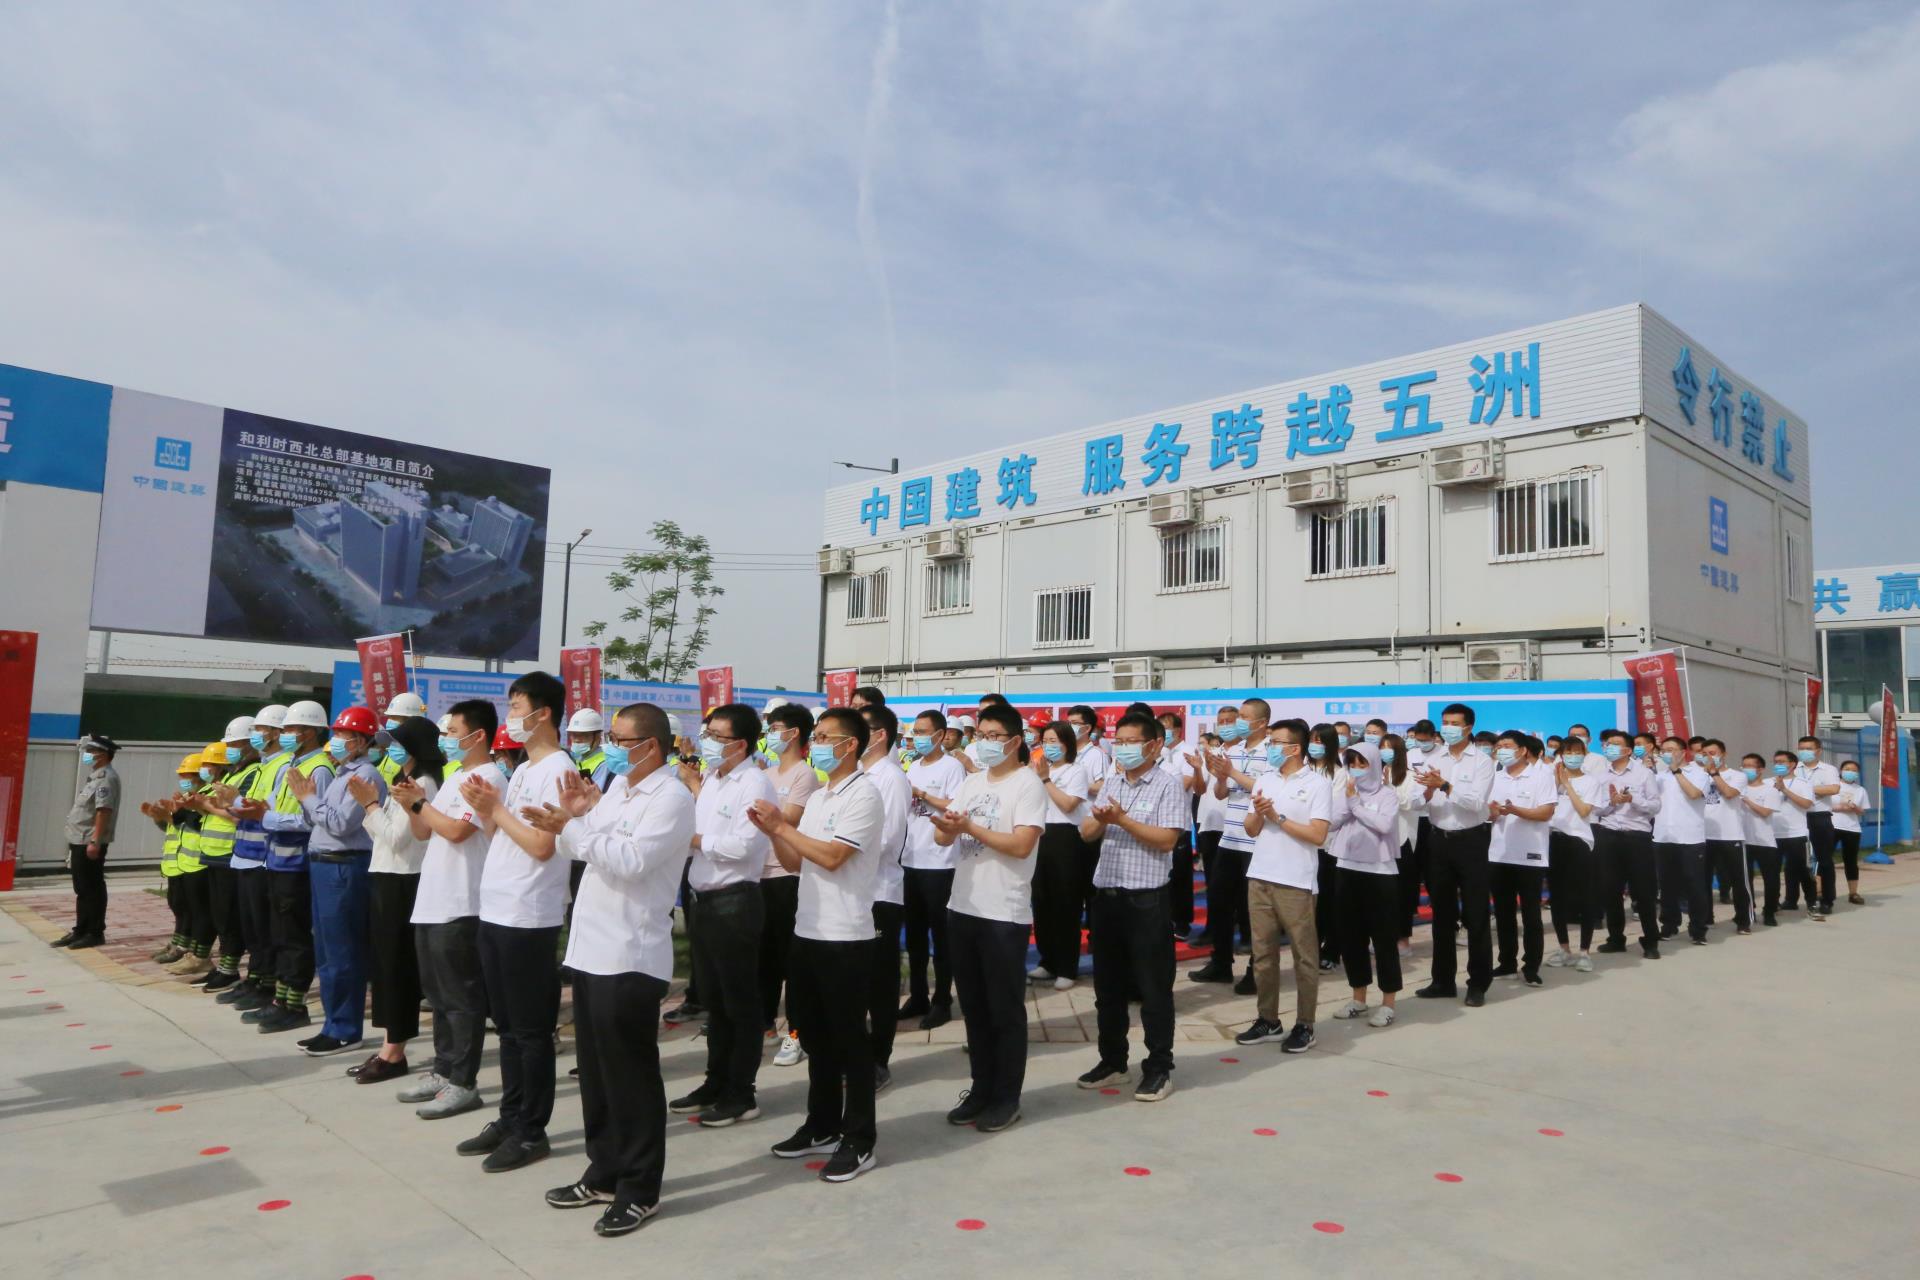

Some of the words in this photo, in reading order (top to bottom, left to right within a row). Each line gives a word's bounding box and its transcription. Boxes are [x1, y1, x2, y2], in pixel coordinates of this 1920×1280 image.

[239, 431, 435, 477] 和利时西北总部基地项目简介
[861, 455, 1037, 536] 中国建筑
[1082, 342, 1541, 496] 服务跨越五洲
[1672, 345, 1796, 484] 令行禁止
